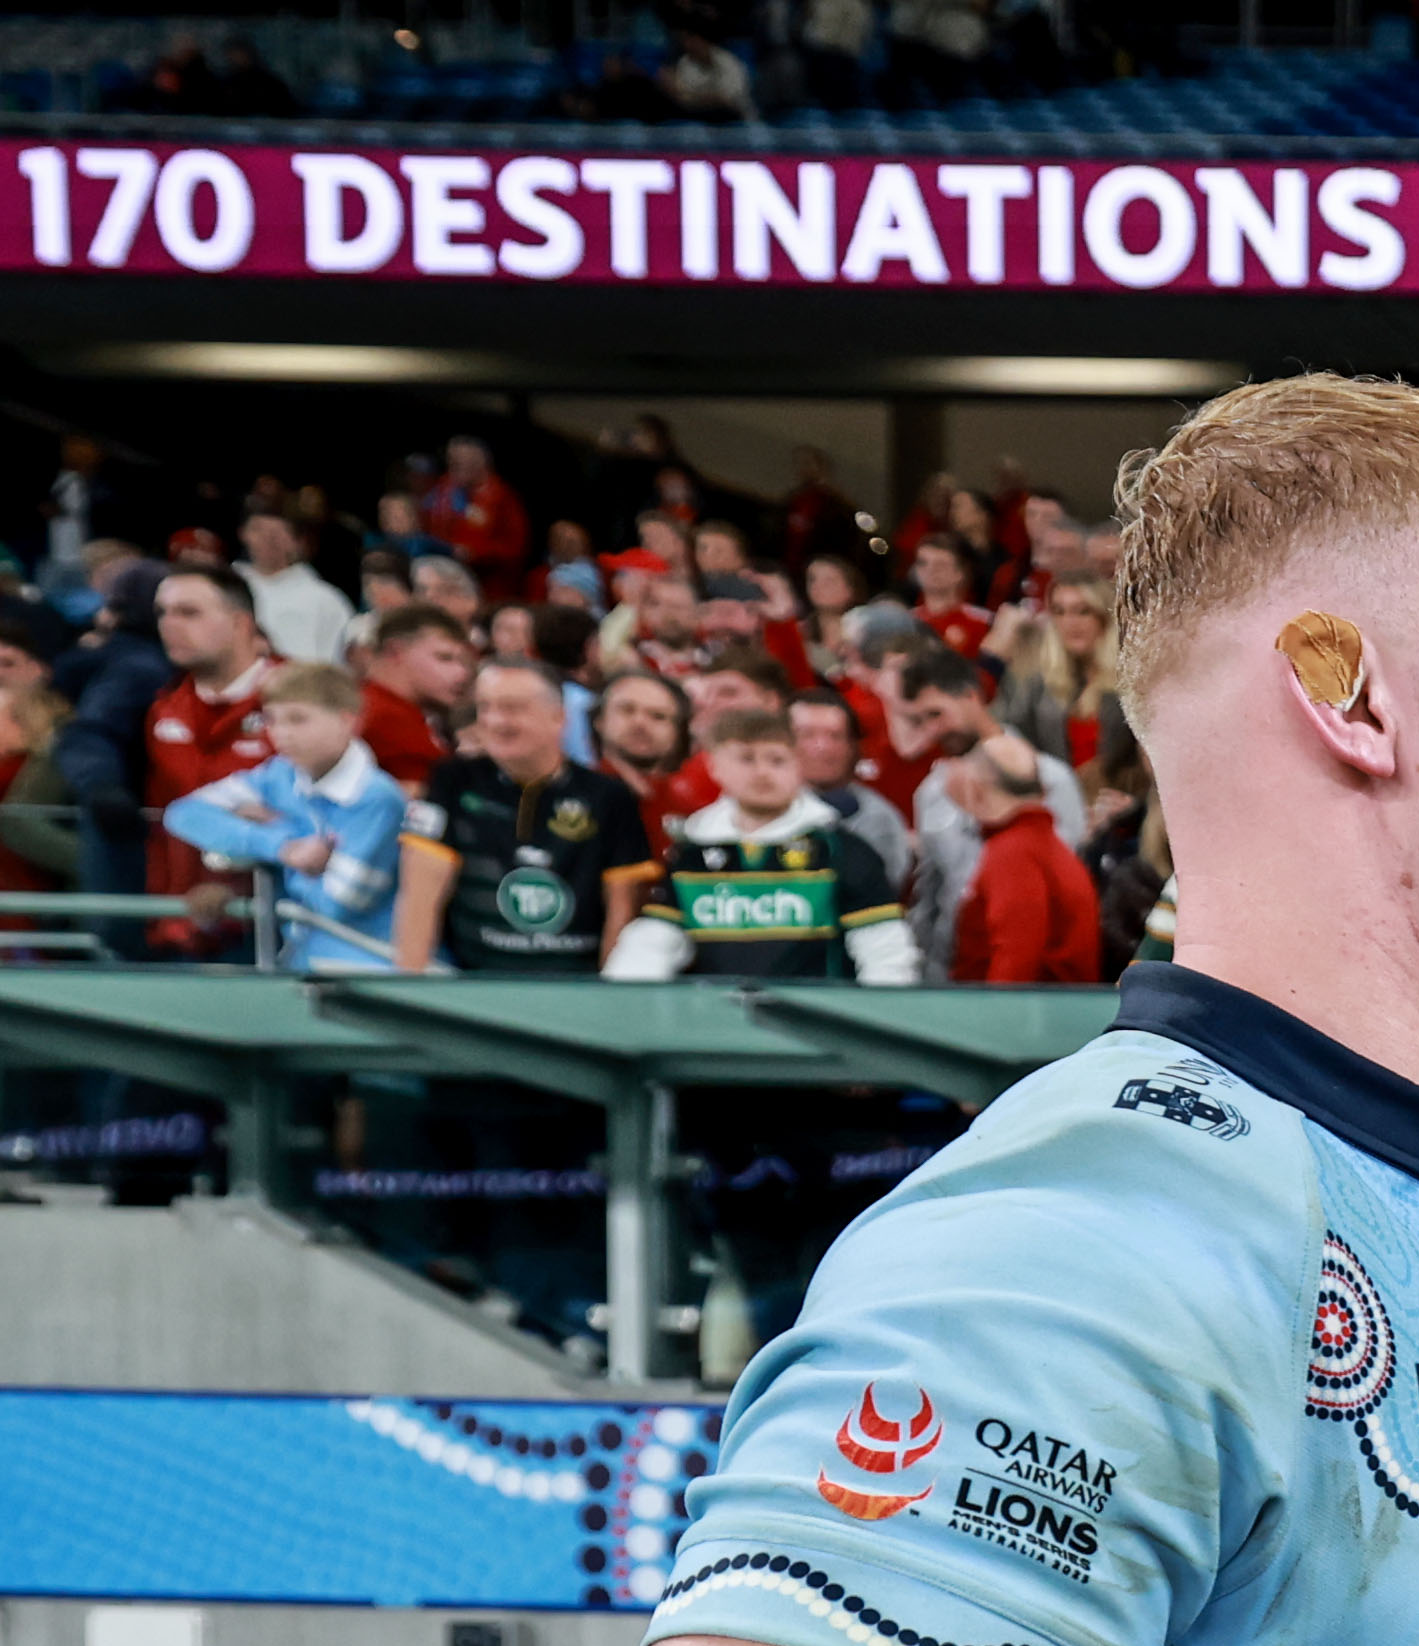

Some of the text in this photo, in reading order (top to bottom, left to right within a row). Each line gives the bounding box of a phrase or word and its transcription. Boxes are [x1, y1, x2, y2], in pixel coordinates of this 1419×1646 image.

[19, 147, 1405, 290] 170 DESTINATIONS
[692, 883, 812, 926] cinch
[976, 1418, 1117, 1495] QATAR
[1005, 1460, 1108, 1514] AIRWAYS
[948, 1519, 1045, 1564] AUSTRALIA
[955, 1477, 1098, 1555] LIONS
[1026, 1533, 1091, 1572] SERIES
